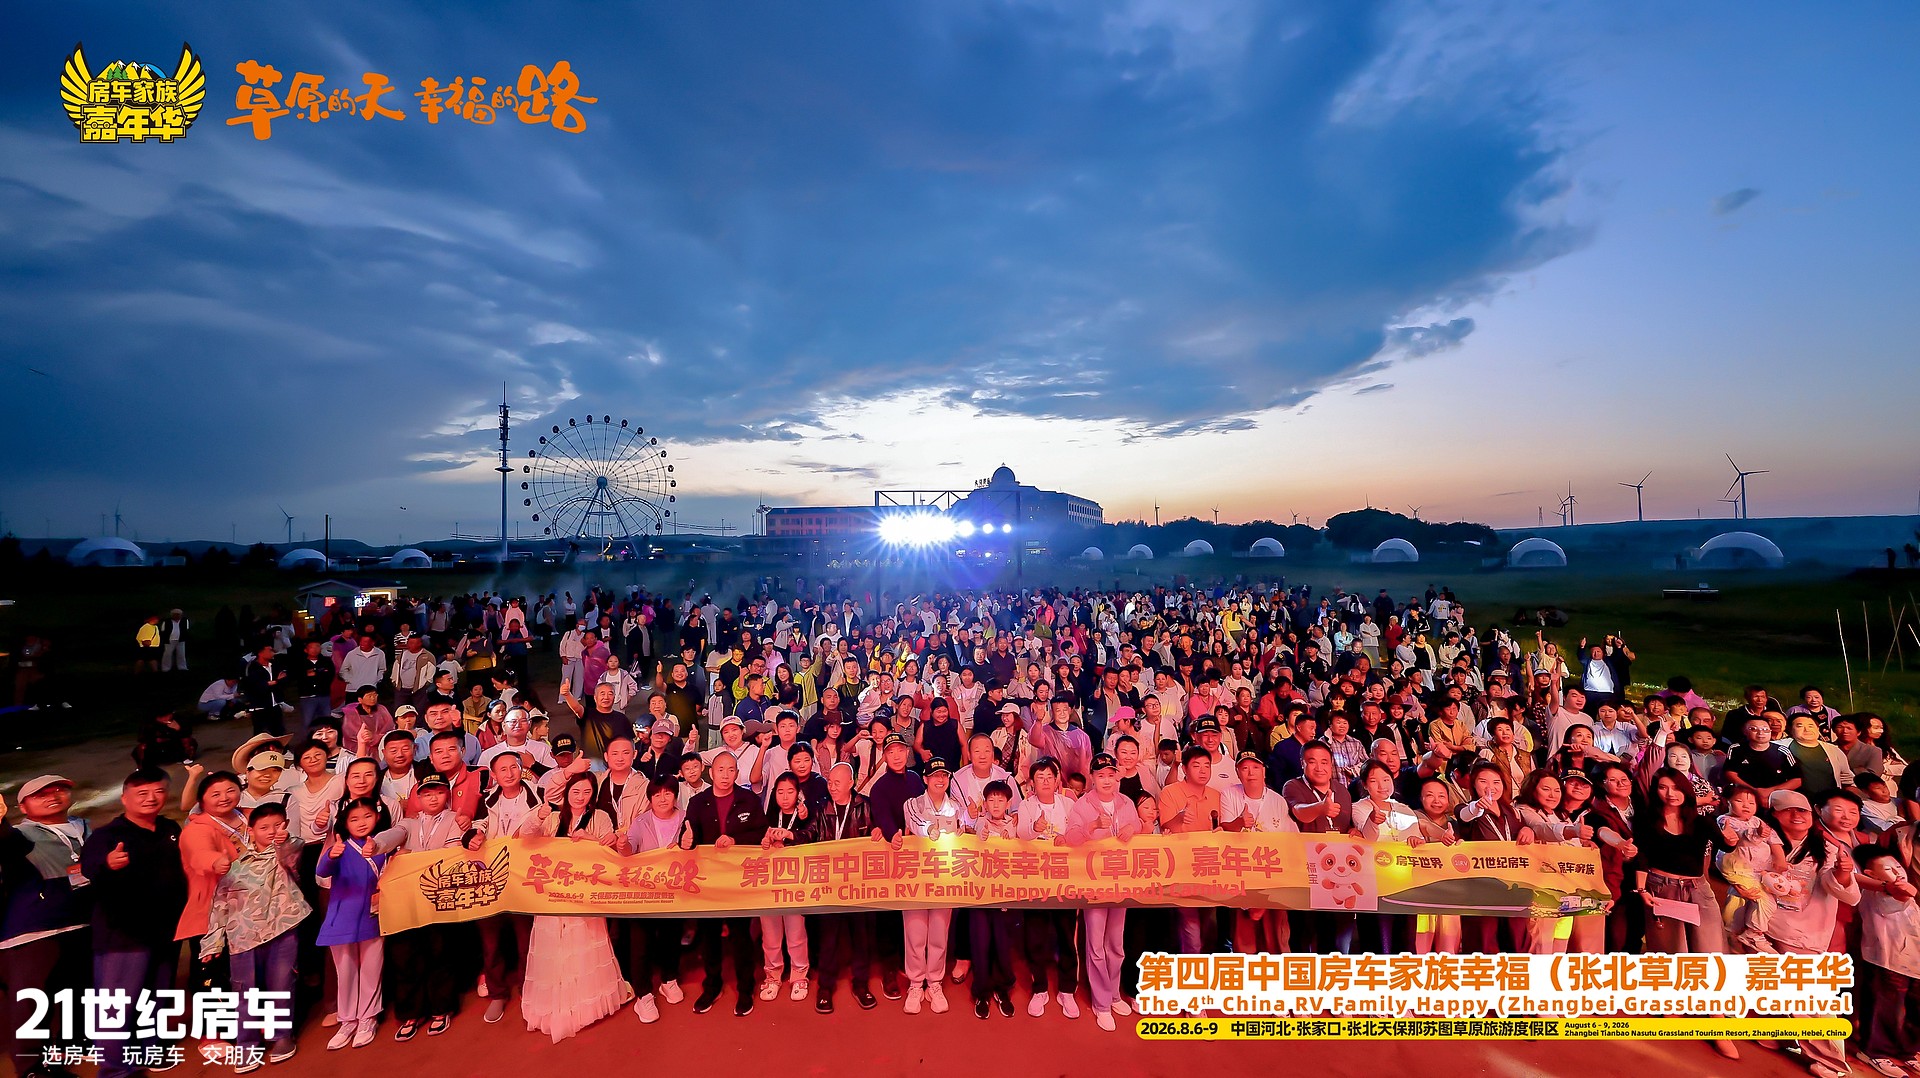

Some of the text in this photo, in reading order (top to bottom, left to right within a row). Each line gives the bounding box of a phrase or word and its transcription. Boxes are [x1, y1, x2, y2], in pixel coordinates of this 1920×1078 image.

[522, 853, 707, 894] 草原的天 幸福的路
[740, 845, 1283, 888] 第四届中国房车家族幸福（草原）嘉年华
[1306, 862, 1319, 885] 福宝
[1396, 855, 1443, 869] 房车世界
[1471, 856, 1530, 869] 21世纪房车
[438, 868, 494, 889] 房车家族
[435, 885, 498, 911] 嘉年华
[771, 889, 806, 903] The
[838, 883, 889, 900] China
[895, 883, 919, 898] RV
[925, 881, 986, 900] Family
[991, 882, 1052, 902] Happy
[1056, 881, 1164, 902] (Grassland)
[1169, 880, 1247, 898] Carnival
